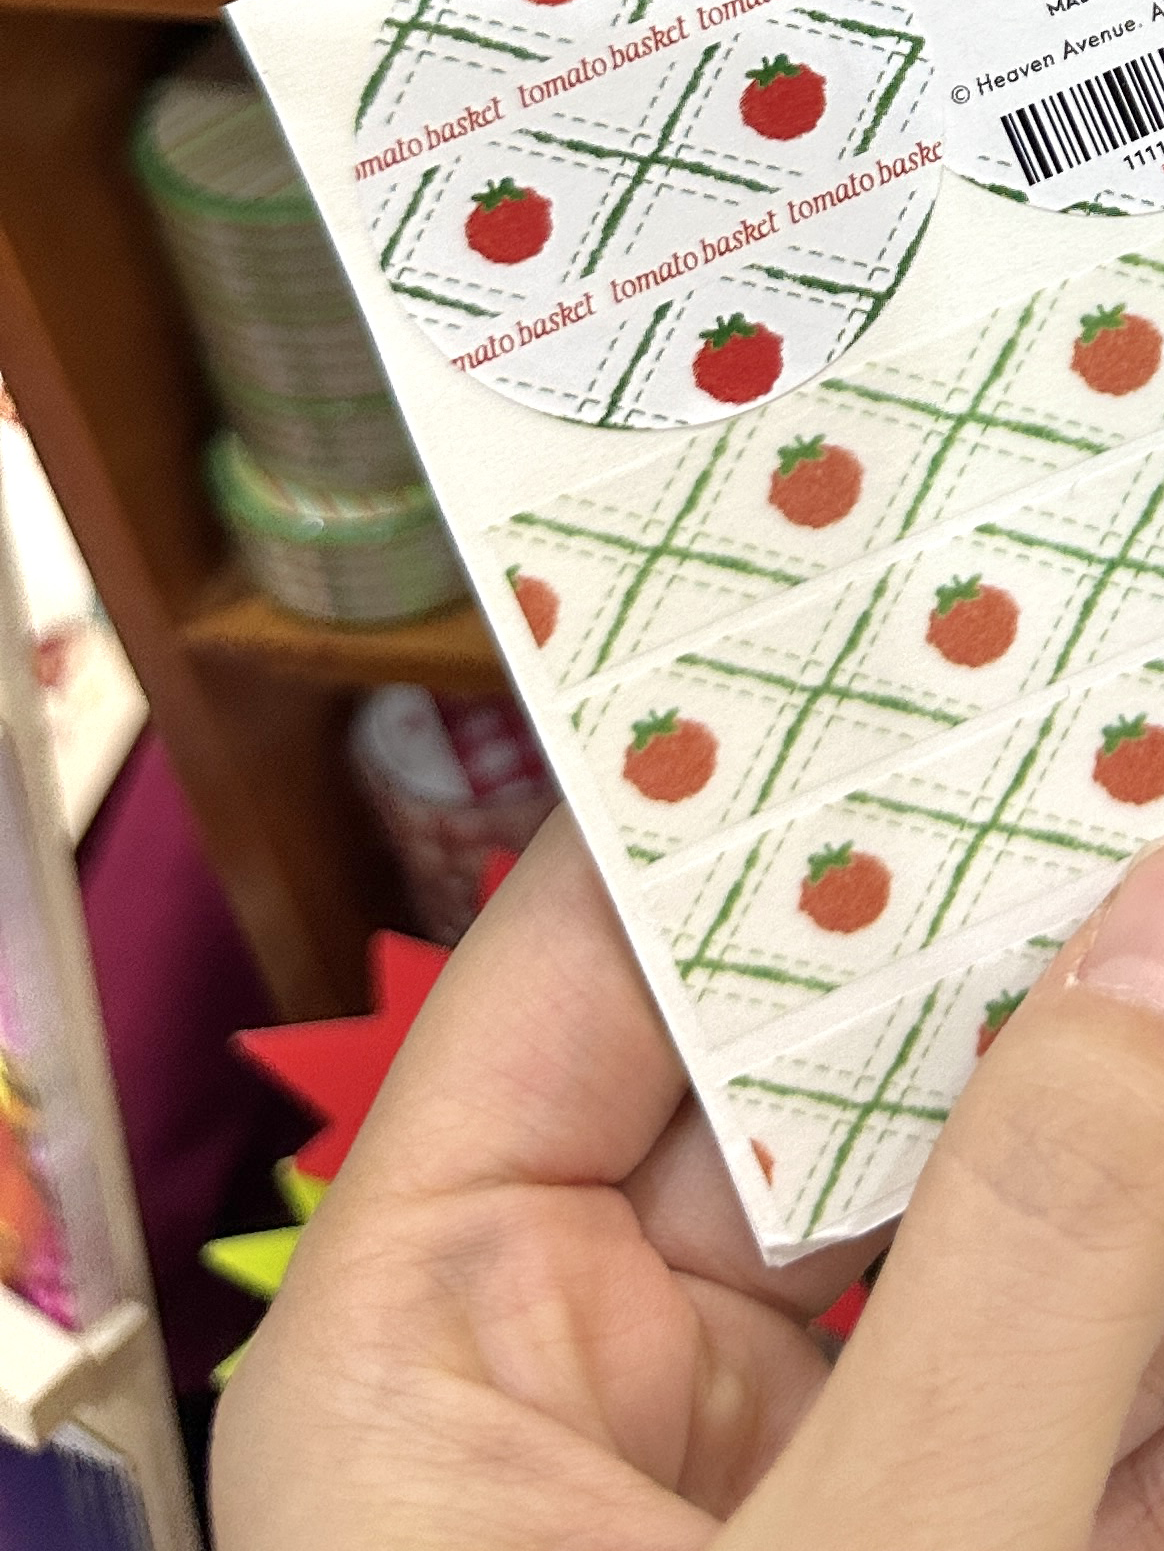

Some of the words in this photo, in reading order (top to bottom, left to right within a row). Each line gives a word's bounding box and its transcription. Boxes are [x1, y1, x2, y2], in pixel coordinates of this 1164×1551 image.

[354, 137, 423, 181] mato
[423, 97, 506, 151] basket
[516, 55, 607, 109] tomato
[610, 20, 691, 71] basket
[975, 53, 1055, 97] Heaven
[1062, 19, 1143, 58] Avenue.
[515, 292, 597, 347] basket
[610, 249, 698, 304] tomato
[700, 210, 781, 264] basket
[787, 173, 875, 224] tomato
